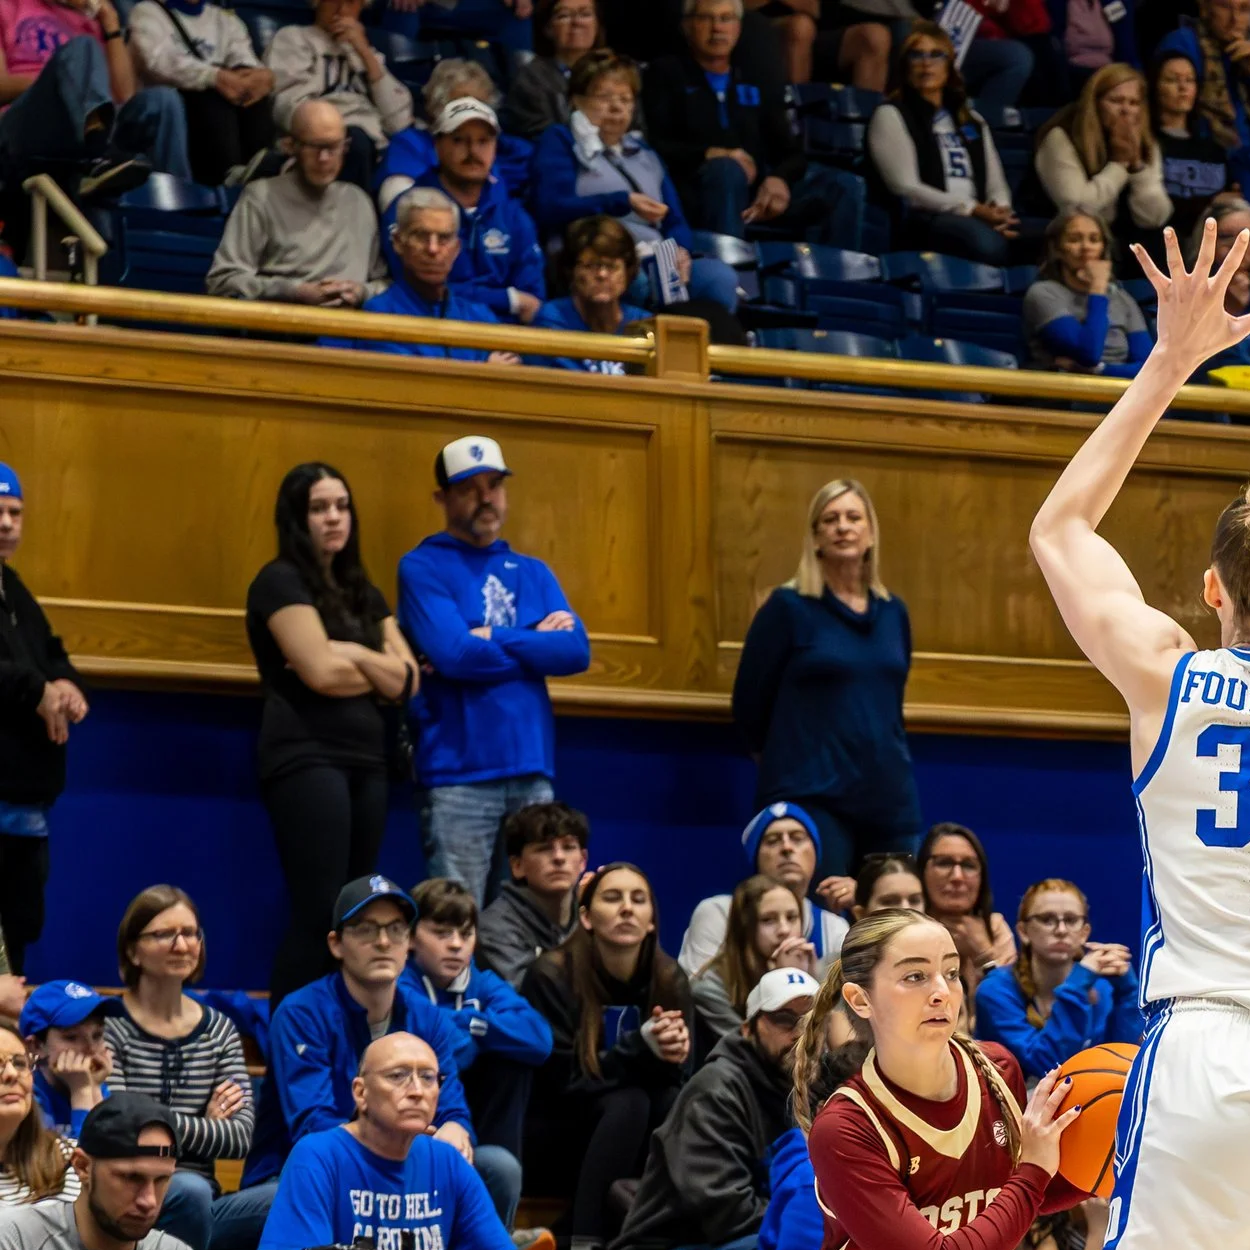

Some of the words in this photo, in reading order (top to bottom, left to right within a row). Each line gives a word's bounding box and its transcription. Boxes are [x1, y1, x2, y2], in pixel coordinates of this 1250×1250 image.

[350, 1189, 374, 1217] GO
[376, 1193, 400, 1220] TO
[919, 1187, 1002, 1236] OST
